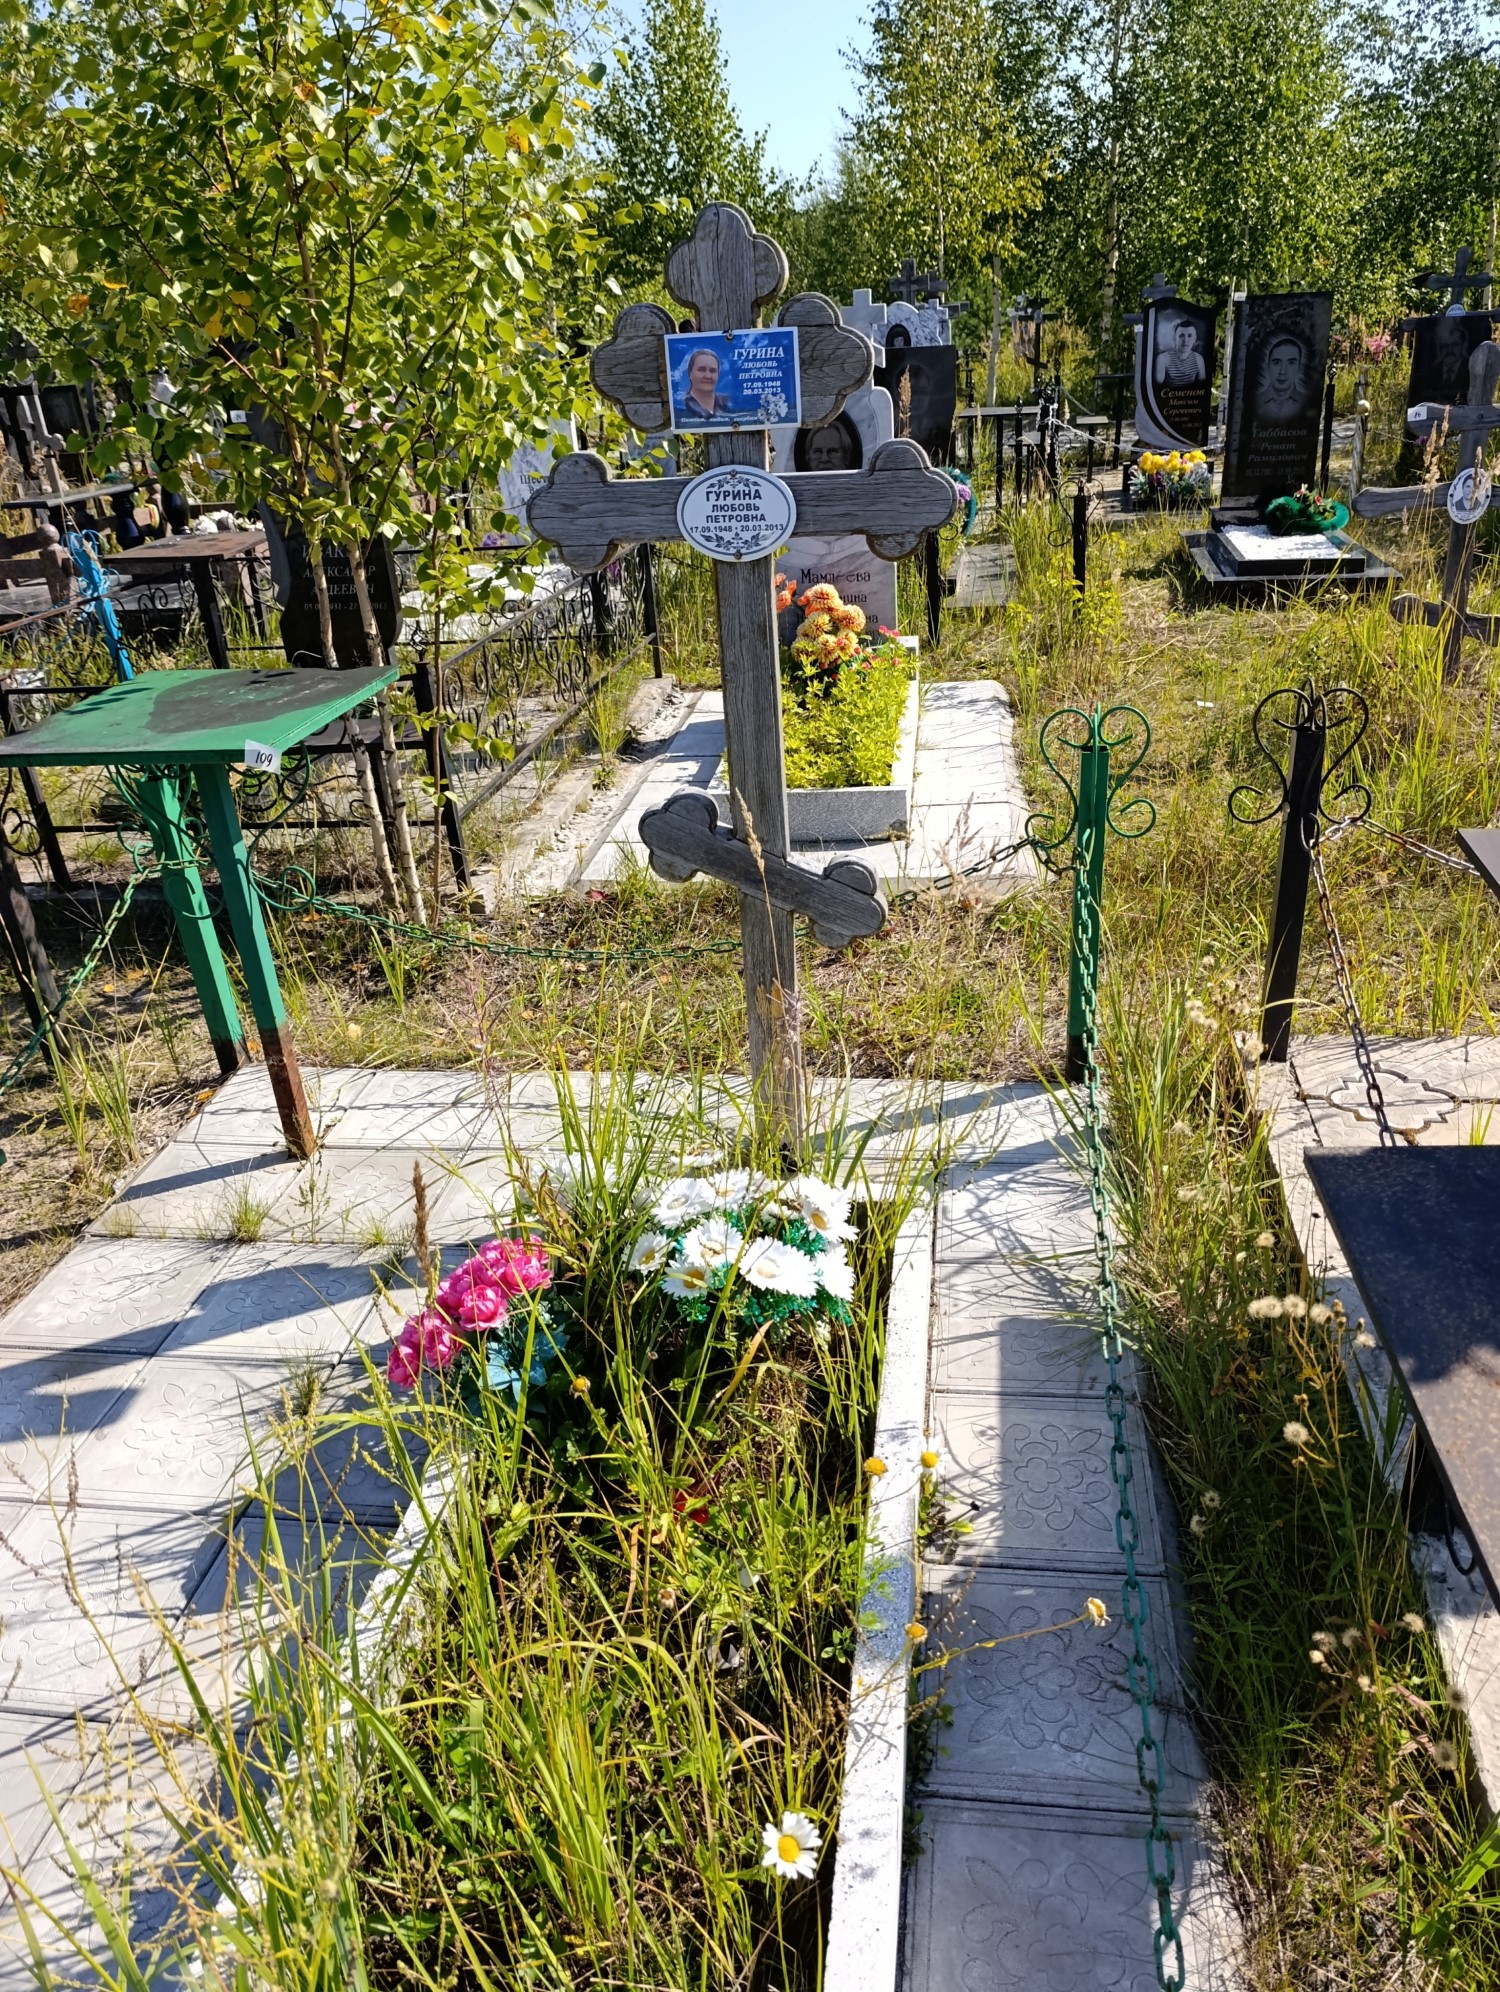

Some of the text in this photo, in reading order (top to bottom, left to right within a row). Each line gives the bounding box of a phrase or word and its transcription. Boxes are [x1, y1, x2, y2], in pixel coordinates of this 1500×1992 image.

[733, 347, 785, 360] ГУРИНА
[742, 361, 778, 369] ЛЮБОВЬ
[738, 371, 783, 379] ПЕТРОВНА
[1161, 388, 1205, 398] Семенов
[706, 489, 762, 501] ГУРИНА
[711, 503, 760, 513] ЛЮБОВЬ
[706, 514, 766, 523] ПЕТРОВНА
[690, 524, 784, 533] 17.09.1948 20.03.2013
[255, 751, 273, 767] 109
